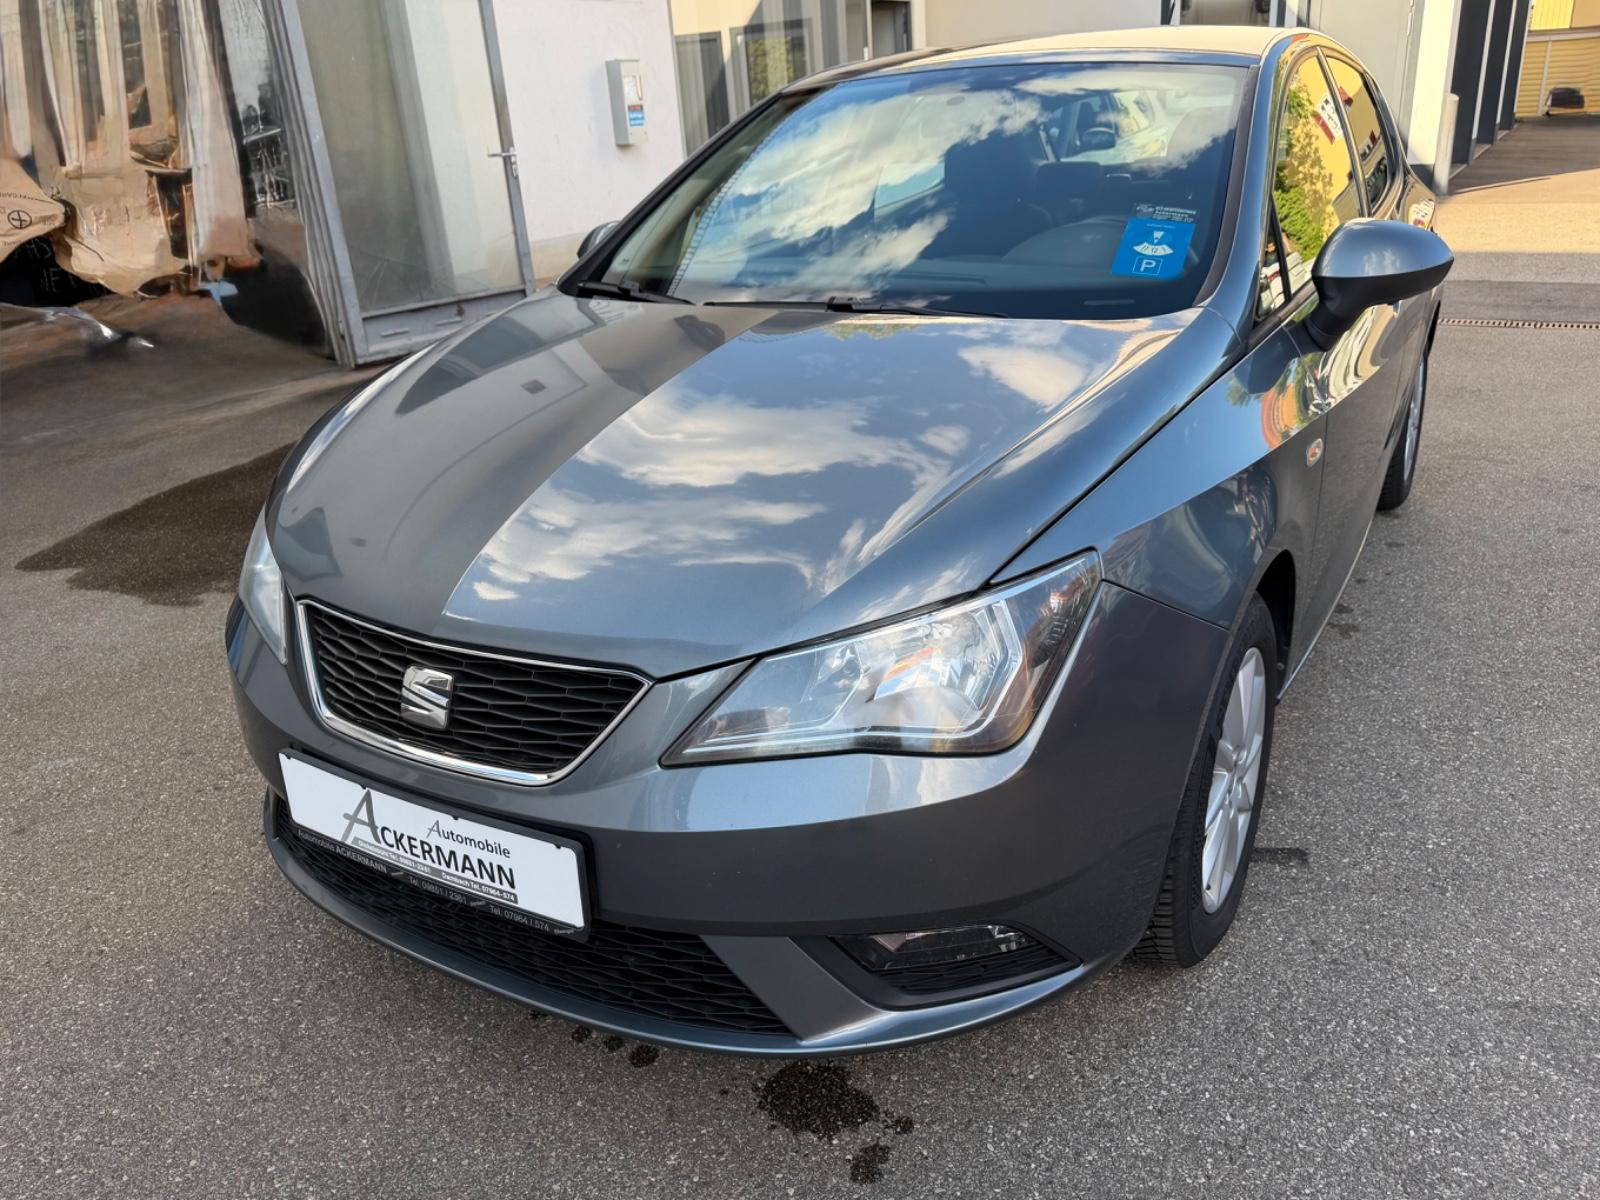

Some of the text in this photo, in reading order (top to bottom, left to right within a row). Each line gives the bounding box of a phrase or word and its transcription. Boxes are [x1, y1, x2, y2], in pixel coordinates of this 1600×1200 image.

[1140, 259, 1156, 272] P
[340, 789, 516, 889] ACKERMANN
[426, 820, 511, 858] Automobile
[336, 846, 388, 873] ACKERMANN
